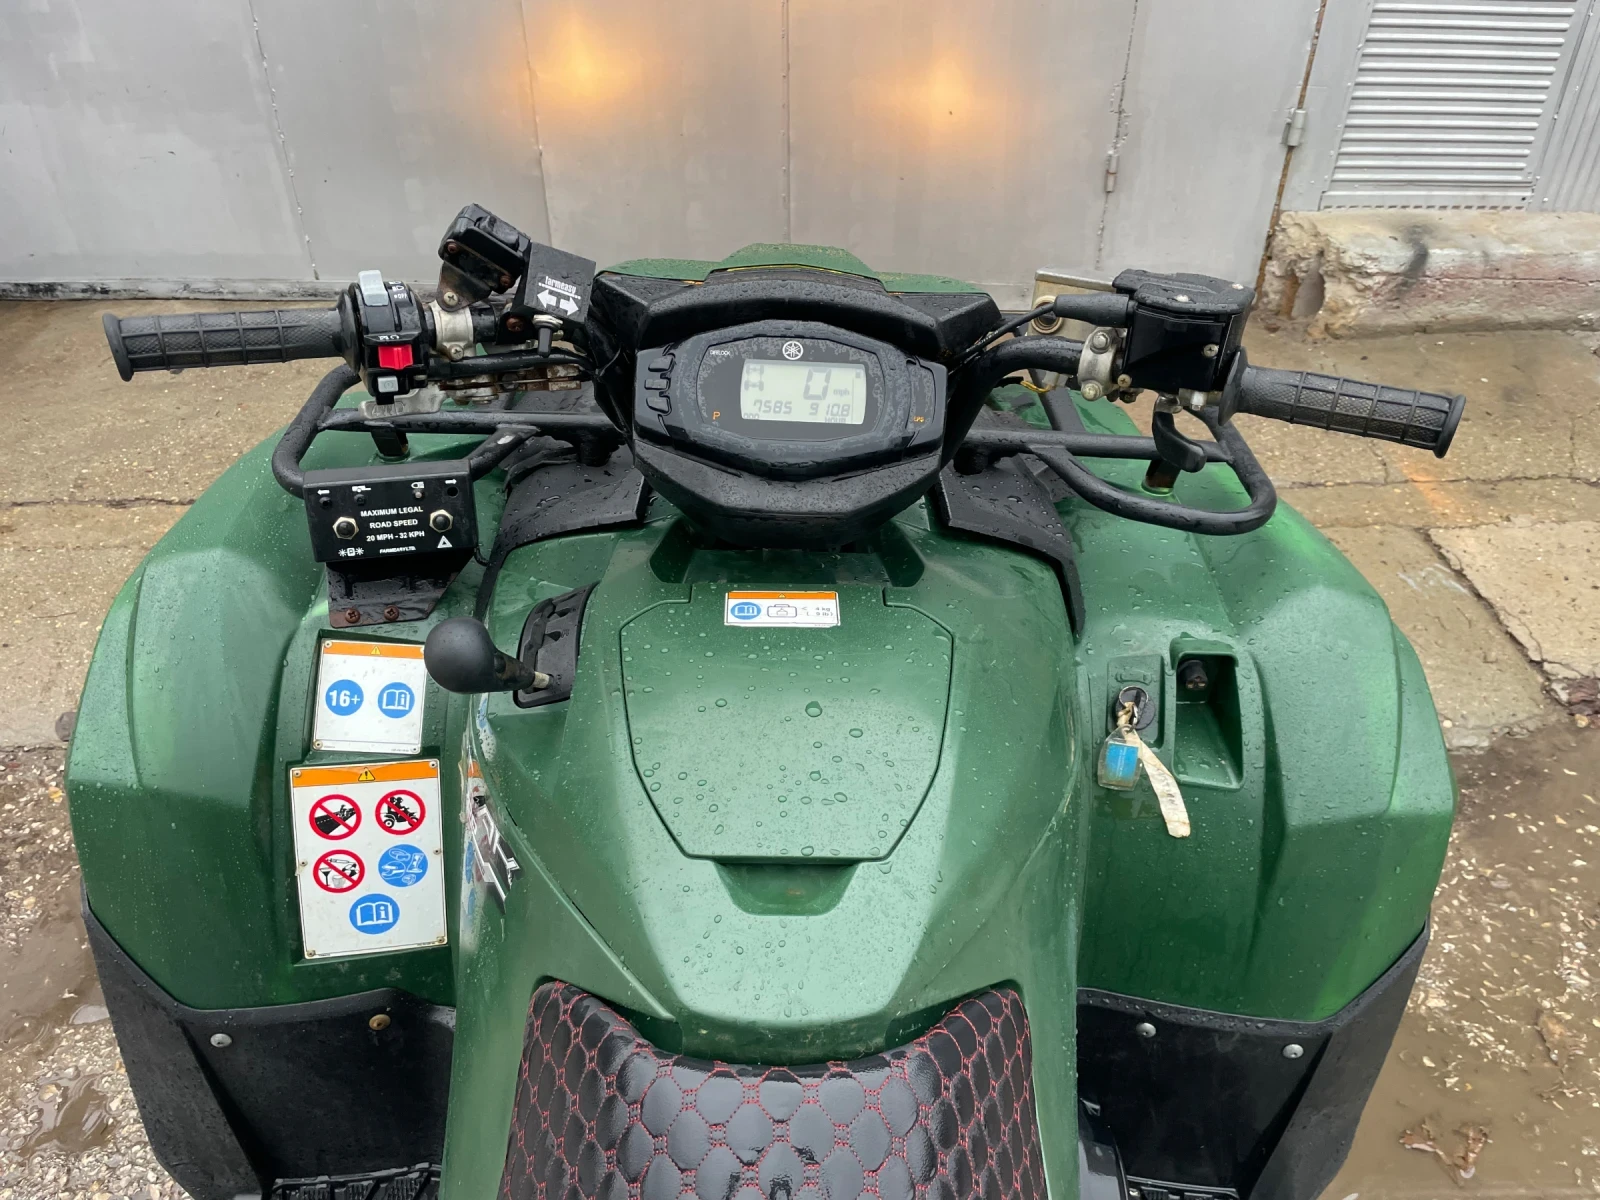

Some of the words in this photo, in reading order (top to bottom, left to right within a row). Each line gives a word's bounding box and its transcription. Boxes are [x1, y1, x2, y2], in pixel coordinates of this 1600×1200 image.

[545, 276, 577, 295] farmeasy
[803, 367, 831, 401] 0
[833, 388, 850, 397] mph
[753, 399, 792, 415] 7585
[712, 411, 721, 420] P
[360, 508, 398, 517] MAXIMUM
[399, 505, 424, 514] LEGAL
[369, 520, 392, 529] ROAD
[393, 518, 418, 527] SPEED
[377, 533, 394, 541] MPH
[409, 530, 425, 538] KPH
[329, 689, 361, 707] 16+
